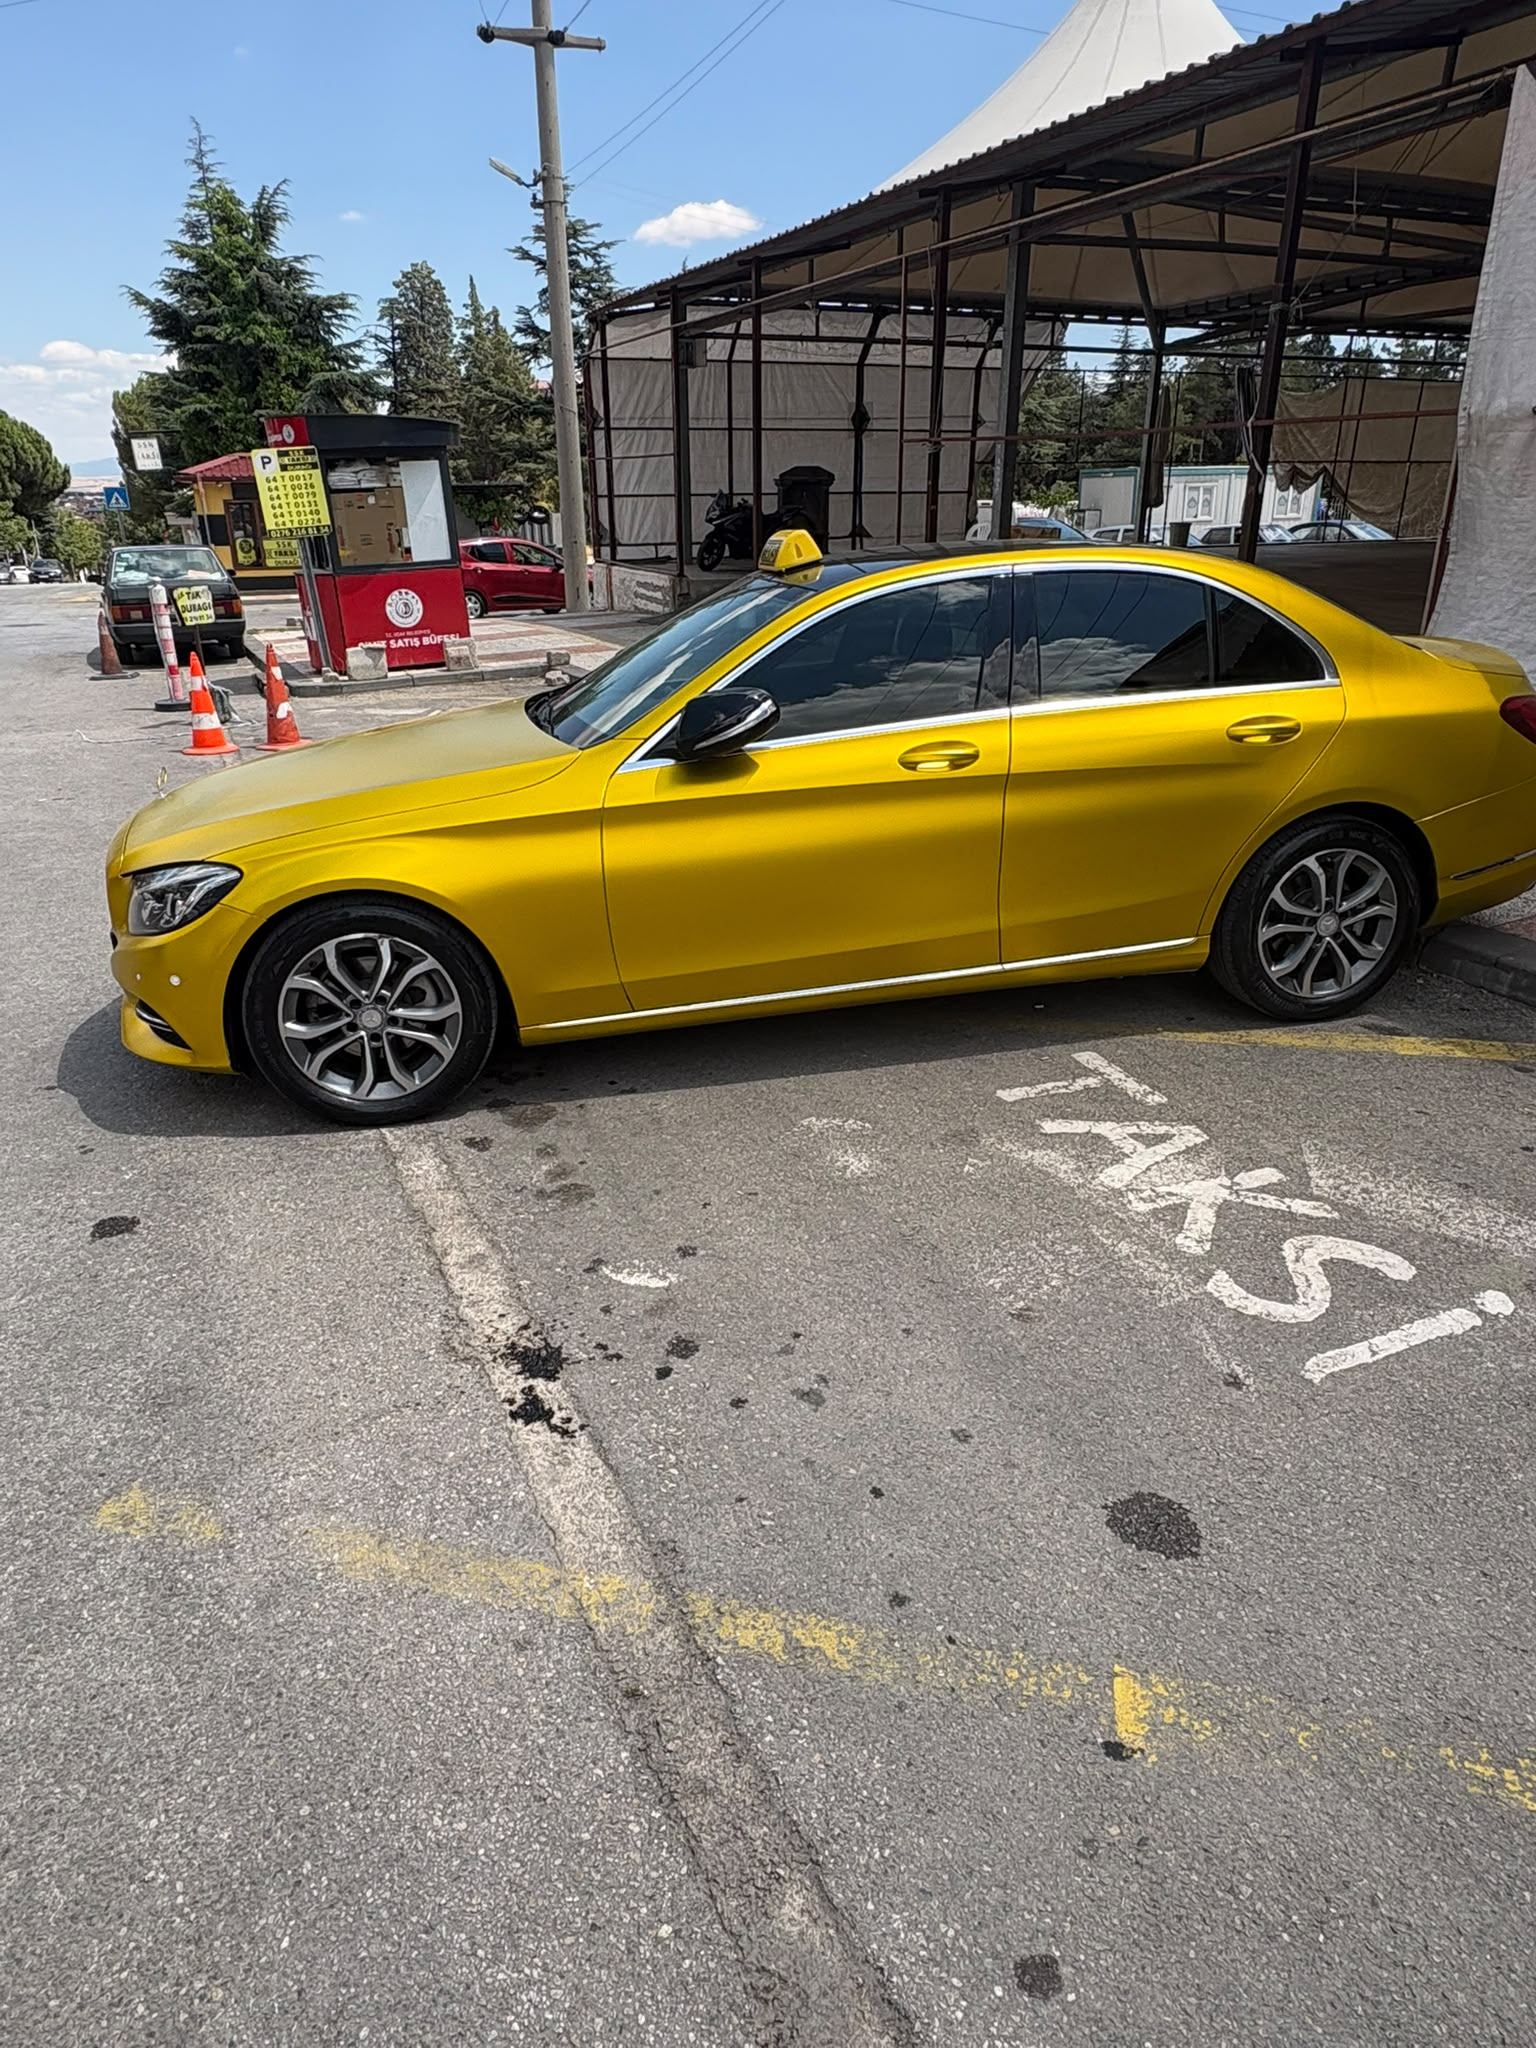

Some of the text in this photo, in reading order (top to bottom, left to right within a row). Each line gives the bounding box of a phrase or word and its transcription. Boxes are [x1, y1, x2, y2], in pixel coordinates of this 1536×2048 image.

[261, 456, 272, 470] P
[265, 473, 314, 484] 64 T 0017
[267, 482, 316, 493] 64 T 0026
[269, 491, 318, 502] 64 T 0079
[270, 500, 319, 511] 64 T 0131
[272, 508, 321, 520] 64 T 0140
[274, 517, 322, 528] 64 T 0224
[270, 526, 329, 538] 0276 216 81 34
[389, 637, 421, 649] SATIŞ
[996, 1050, 1516, 1386] TAKSİ
